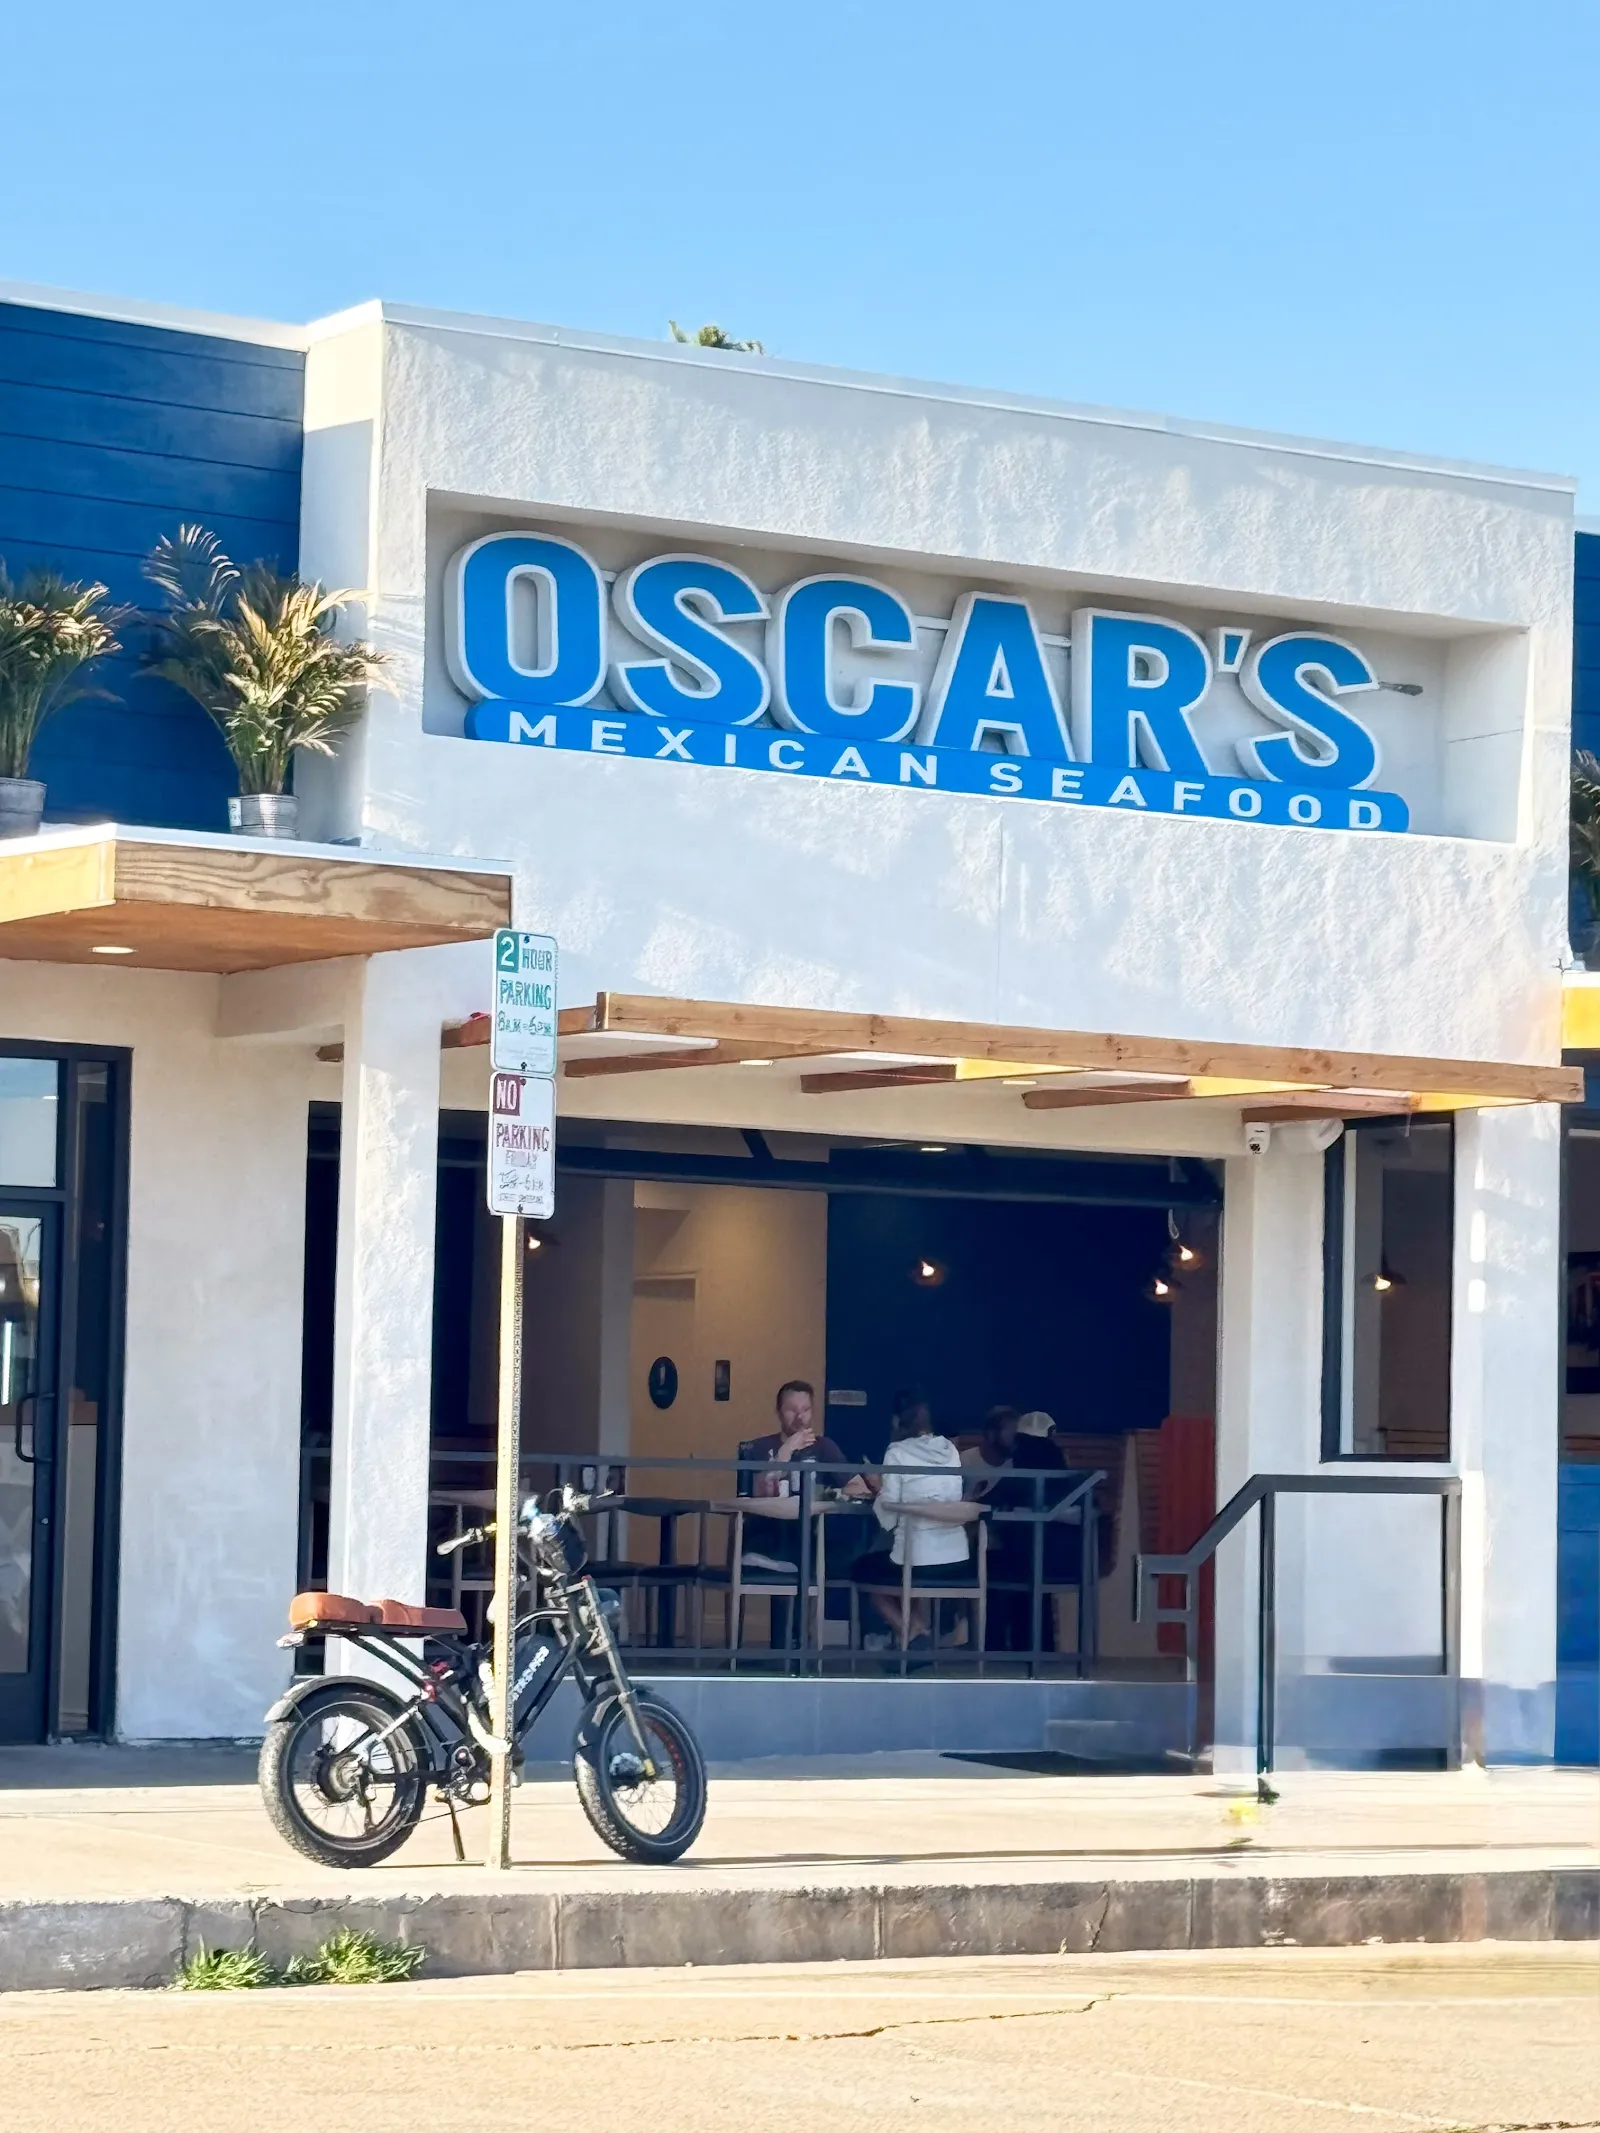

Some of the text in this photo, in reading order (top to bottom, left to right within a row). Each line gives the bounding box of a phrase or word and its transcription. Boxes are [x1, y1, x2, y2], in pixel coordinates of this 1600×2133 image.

[447, 530, 1381, 791] OSCAR'S
[508, 710, 1383, 830] MEXICAN SEAFOOD
[500, 936, 515, 967] 2
[521, 948, 552, 972] HOUR
[500, 979, 552, 1010] PARKING
[496, 1077, 518, 1110] NO
[496, 1123, 550, 1152] PARKING
